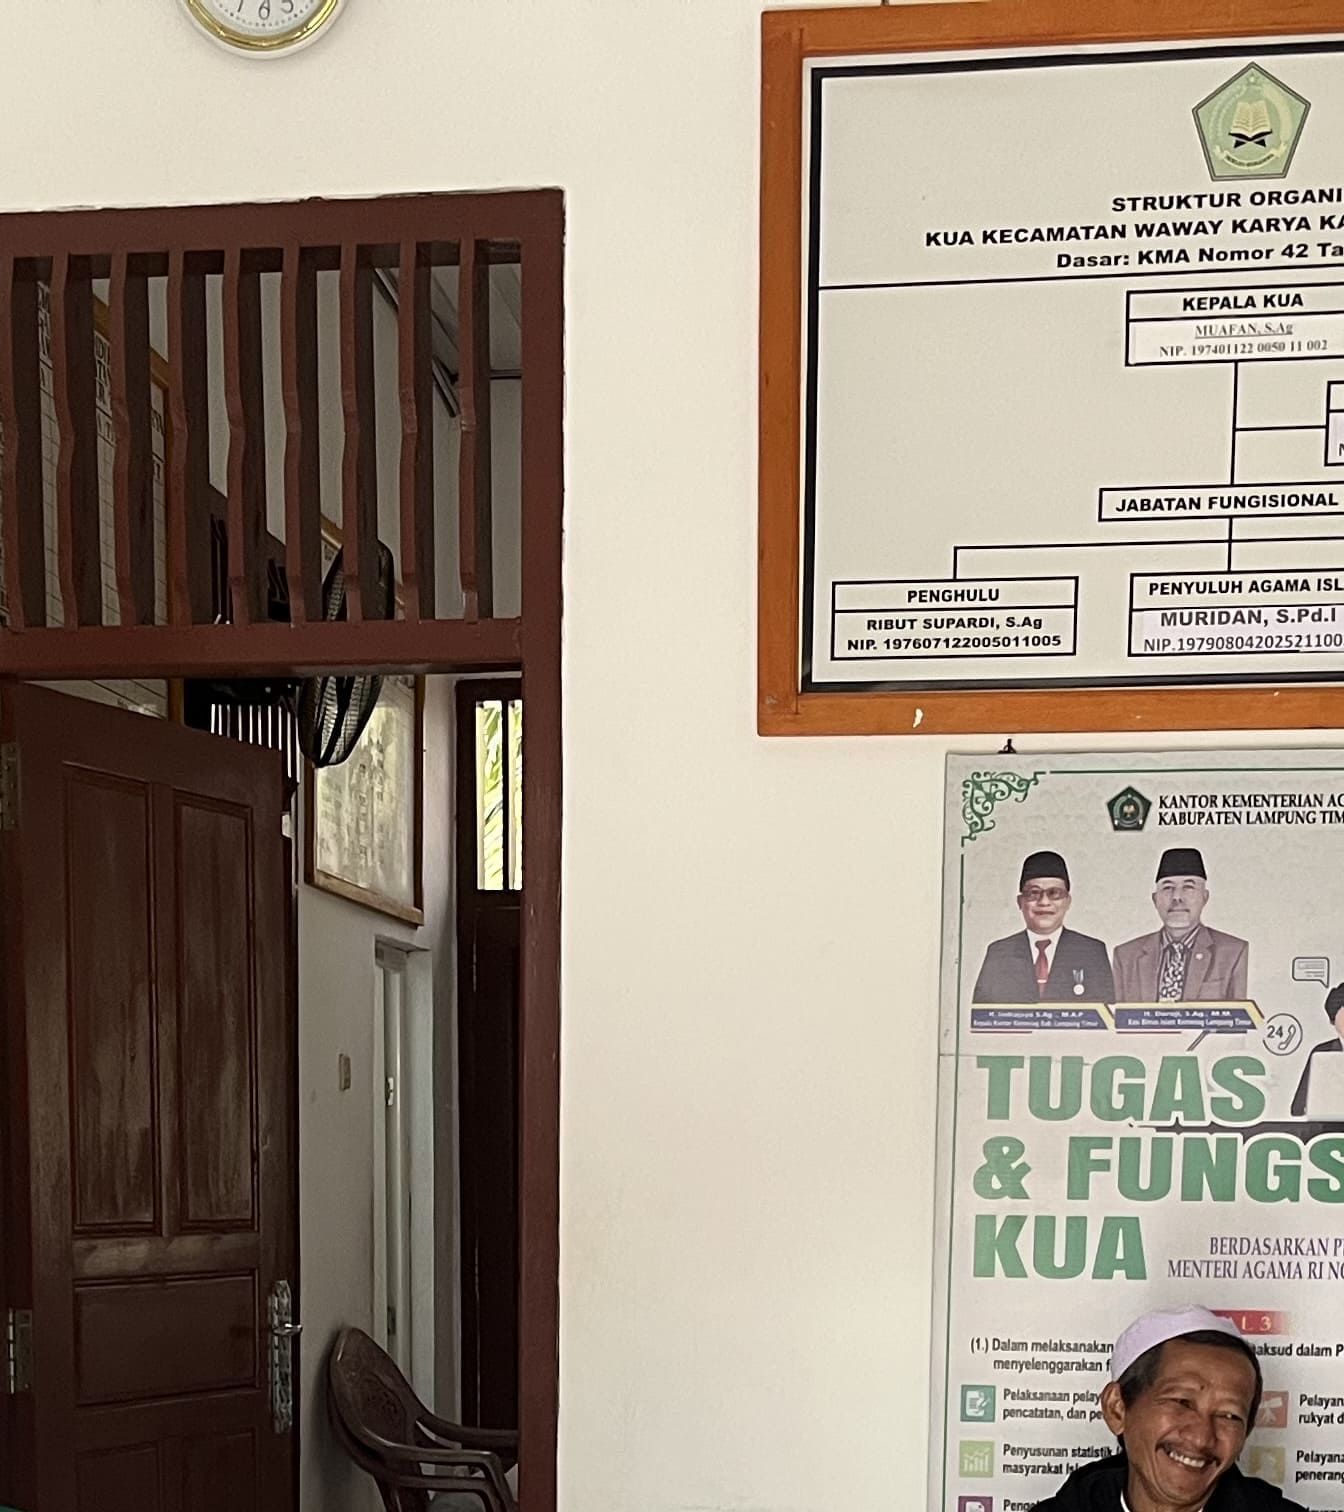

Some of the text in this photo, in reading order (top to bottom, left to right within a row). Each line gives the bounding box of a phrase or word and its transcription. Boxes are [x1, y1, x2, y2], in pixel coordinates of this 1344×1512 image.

[1111, 193, 1242, 212] STRUKTUR
[925, 231, 974, 247] KUA
[982, 224, 1127, 245] KECAMATAN
[1135, 219, 1224, 239] WAWAY
[1231, 215, 1311, 234] KARYA
[1057, 253, 1130, 269] Dasar:
[1137, 249, 1190, 265] KMA
[1198, 246, 1274, 263] Nomor
[1281, 243, 1309, 259] 42
[1182, 293, 1304, 312] KEPALA KUA
[1195, 322, 1294, 337] MUAFAN, S.Ag
[1159, 345, 1187, 357] NIP.
[1191, 343, 1254, 357] 197401122
[1289, 341, 1302, 352] 11
[1306, 339, 1328, 351] 002
[1116, 493, 1339, 512] JABATAN FUNGISIONAL
[907, 589, 1000, 603] PENGHULU
[1149, 581, 1243, 596] PENYULUH
[1248, 579, 1311, 593] AGAMA
[867, 616, 1042, 631] RIBUT SUPARDI, S.Ag
[1160, 607, 1336, 627] MURIDAN, S.Pd.I
[847, 635, 1061, 651] NIP. 197607122005011005
[1158, 795, 1218, 809] KANTOR
[1222, 794, 1324, 808] KEMENTERIAN
[1158, 811, 1242, 825] KABUPATEN
[1246, 811, 1316, 825] LAMPUNG
[1267, 1026, 1283, 1038] 24
[976, 1055, 1267, 1123] TUGAS
[972, 1135, 1032, 1200] &
[972, 1214, 1148, 1280] KUA
[1209, 1236, 1329, 1257] BERDASARKAN
[1167, 1259, 1238, 1279] MENTERI
[1242, 1261, 1303, 1280] AGAMA
[1308, 1262, 1324, 1280] RI
[1259, 1316, 1272, 1331] 3
[970, 1337, 1114, 1354] (1.) Dalam melaksanakan
[1296, 1344, 1332, 1357] dalam
[993, 1358, 1103, 1375] menyelenggarakan
[1003, 1388, 1070, 1402] Pelaksanaan
[1002, 1407, 1064, 1421] pencatatan,
[1067, 1408, 1086, 1420] dan
[1298, 1413, 1335, 1427] rukyat
[1003, 1444, 1112, 1460] Penyusunan statistik
[1002, 1463, 1064, 1477] masyarakat
